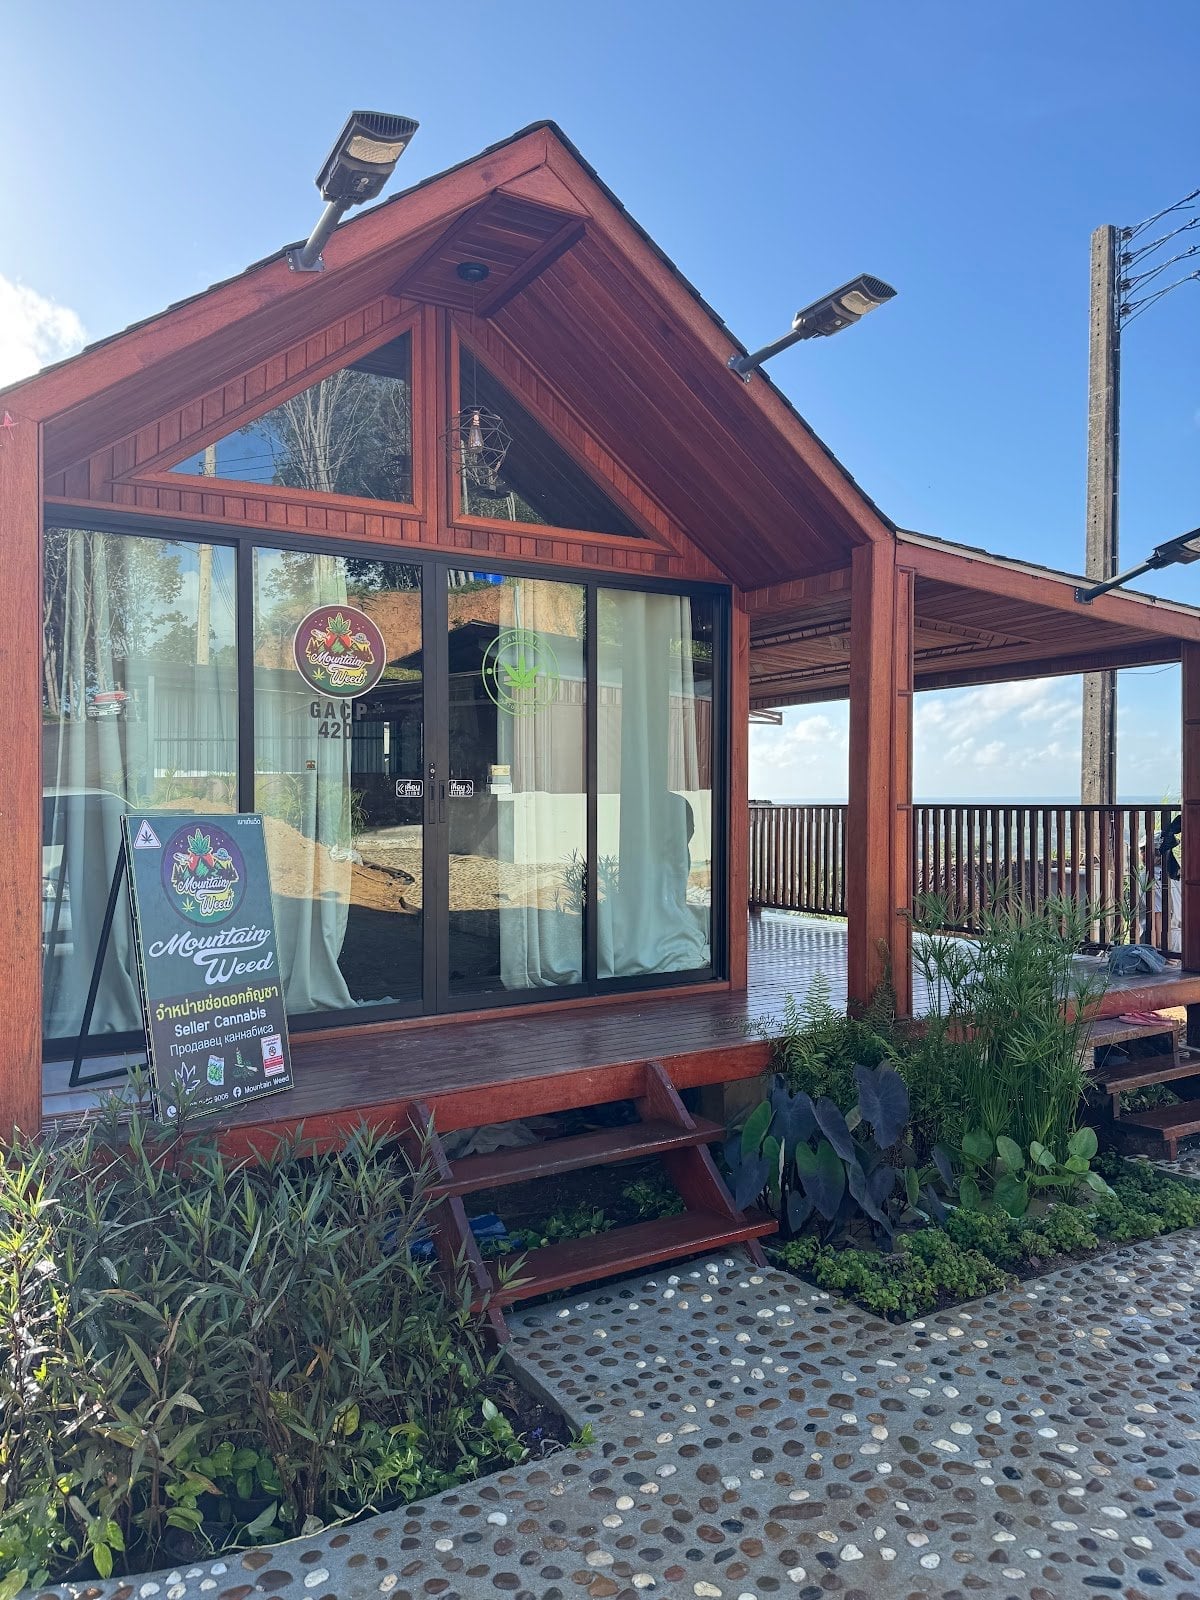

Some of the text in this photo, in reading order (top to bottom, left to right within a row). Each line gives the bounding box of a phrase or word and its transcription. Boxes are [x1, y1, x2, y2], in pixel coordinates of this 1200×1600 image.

[311, 652, 364, 668] Mountain
[330, 667, 364, 685] Weed
[310, 702, 368, 720] GACP
[319, 721, 353, 740] 420
[178, 875, 230, 894] Mountain
[198, 892, 233, 913] Weed
[149, 925, 271, 957] Mountain
[194, 950, 274, 986] Weed
[156, 985, 279, 1021] จำหน่ายช่อดอกกัญชา
[174, 1007, 267, 1037] Seller Cannabis
[170, 1036, 223, 1057] Продавец
[224, 1023, 274, 1043] каннабиса
[244, 1075, 290, 1094] Mountain Weed
